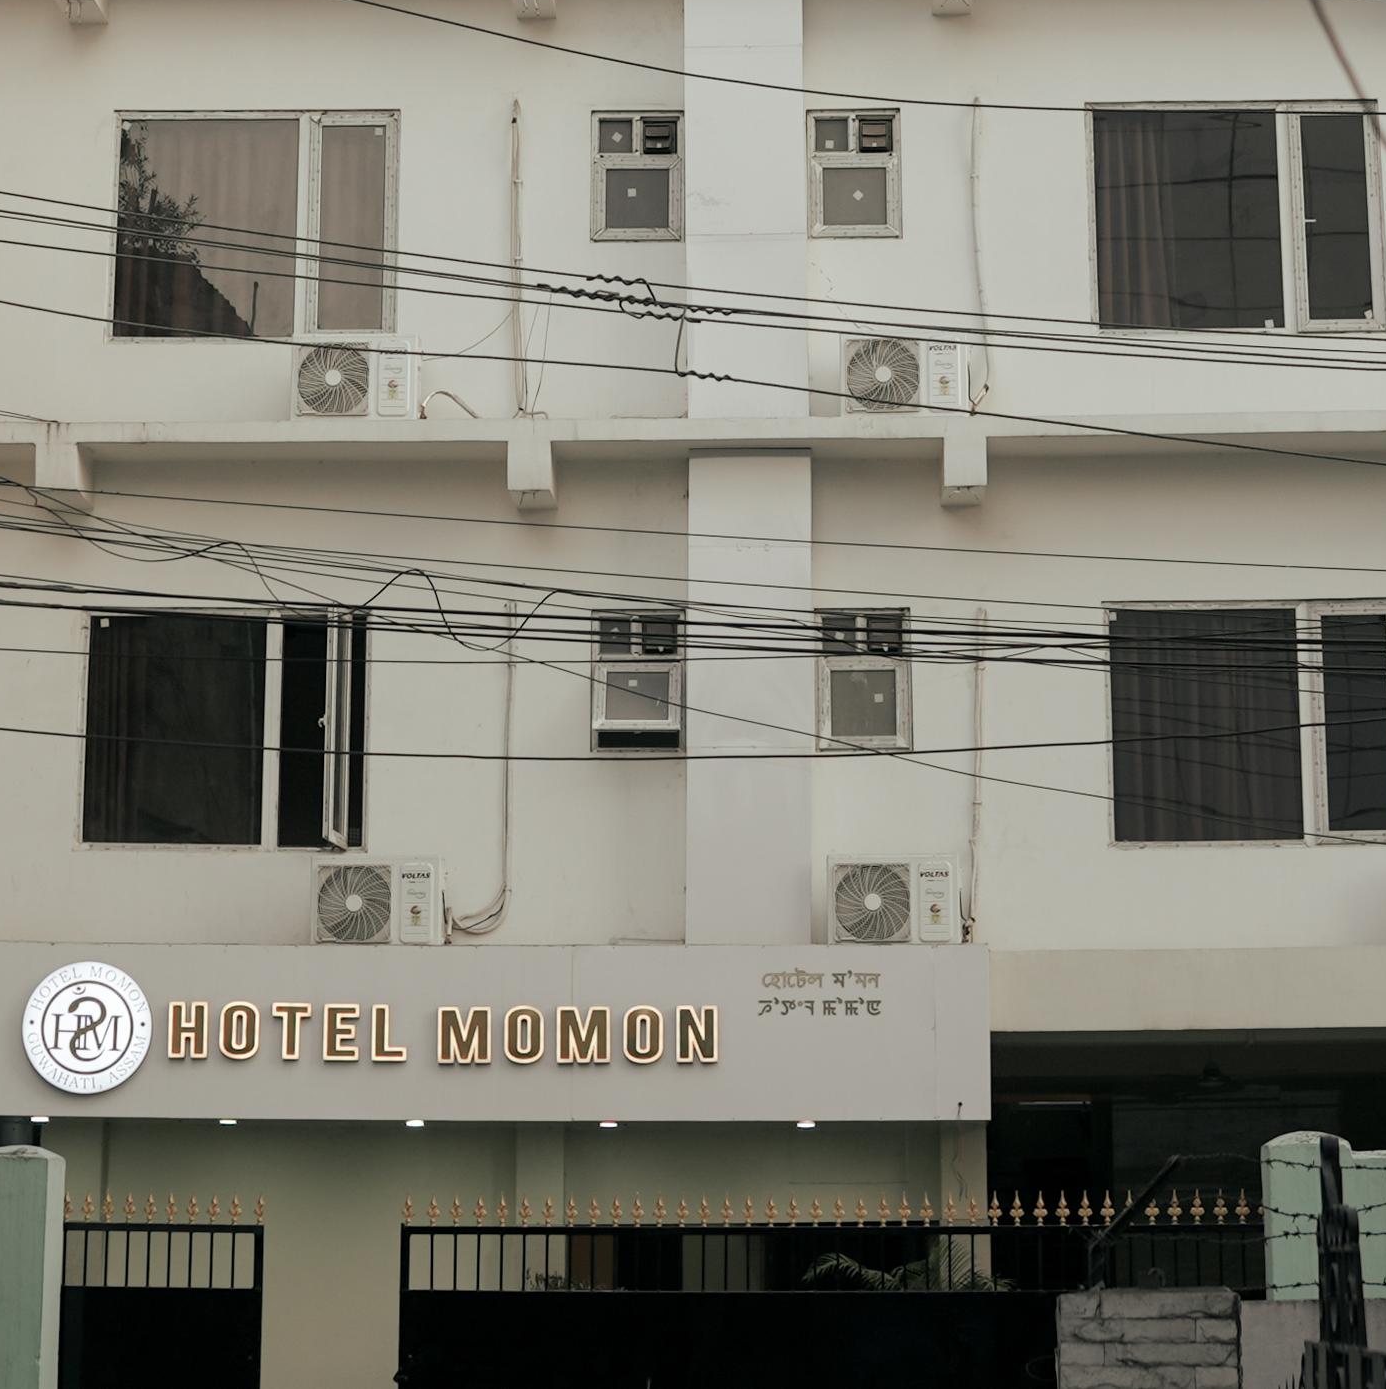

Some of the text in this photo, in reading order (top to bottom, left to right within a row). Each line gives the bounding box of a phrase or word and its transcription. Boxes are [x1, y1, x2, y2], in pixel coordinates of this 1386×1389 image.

[928, 344, 958, 353] VOLTAS
[400, 871, 432, 880] VOLTAS
[918, 870, 950, 879] VOLTAS
[30, 965, 148, 1013] HOTEL MOMON
[762, 967, 824, 990] হোটেল
[167, 1000, 720, 1067] HOTEL MOMON
[27, 1032, 147, 1090] GUWAHATI, ASSAM
